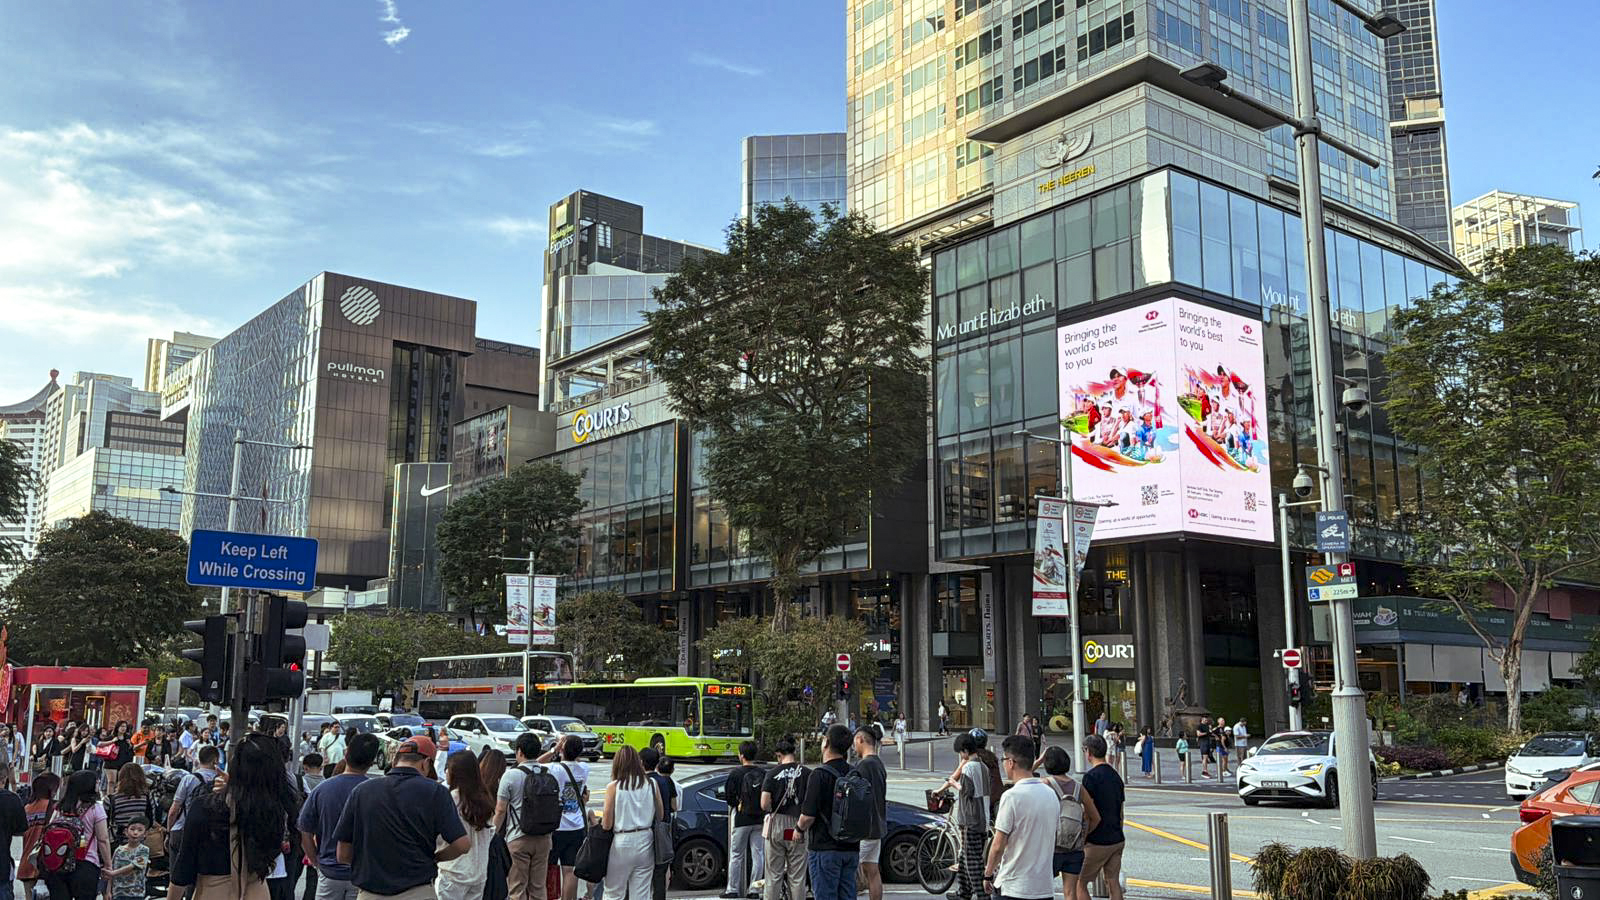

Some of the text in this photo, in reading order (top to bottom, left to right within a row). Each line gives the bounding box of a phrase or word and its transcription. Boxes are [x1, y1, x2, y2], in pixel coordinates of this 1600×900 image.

[1038, 164, 1096, 192] THE HEEREN
[550, 234, 576, 254] Express
[1261, 283, 1300, 311] Mount
[937, 293, 1046, 341] Mount Elizabeth
[1178, 307, 1209, 327] Bringing
[1210, 316, 1222, 329] the
[1064, 323, 1117, 344] Bringing the
[1179, 323, 1206, 338] world's
[1207, 328, 1224, 343] best
[1064, 336, 1118, 357] world's best
[1180, 337, 1204, 351] to you
[327, 362, 385, 380] pullman
[1065, 357, 1093, 370] to you
[333, 372, 378, 383] HOTELS
[574, 402, 631, 440] COURTS
[221, 541, 288, 560] Keep Left
[199, 561, 306, 585] While Crossing
[1105, 570, 1127, 579] THE
[1086, 643, 1134, 660] COURT
[733, 686, 746, 695] 683
